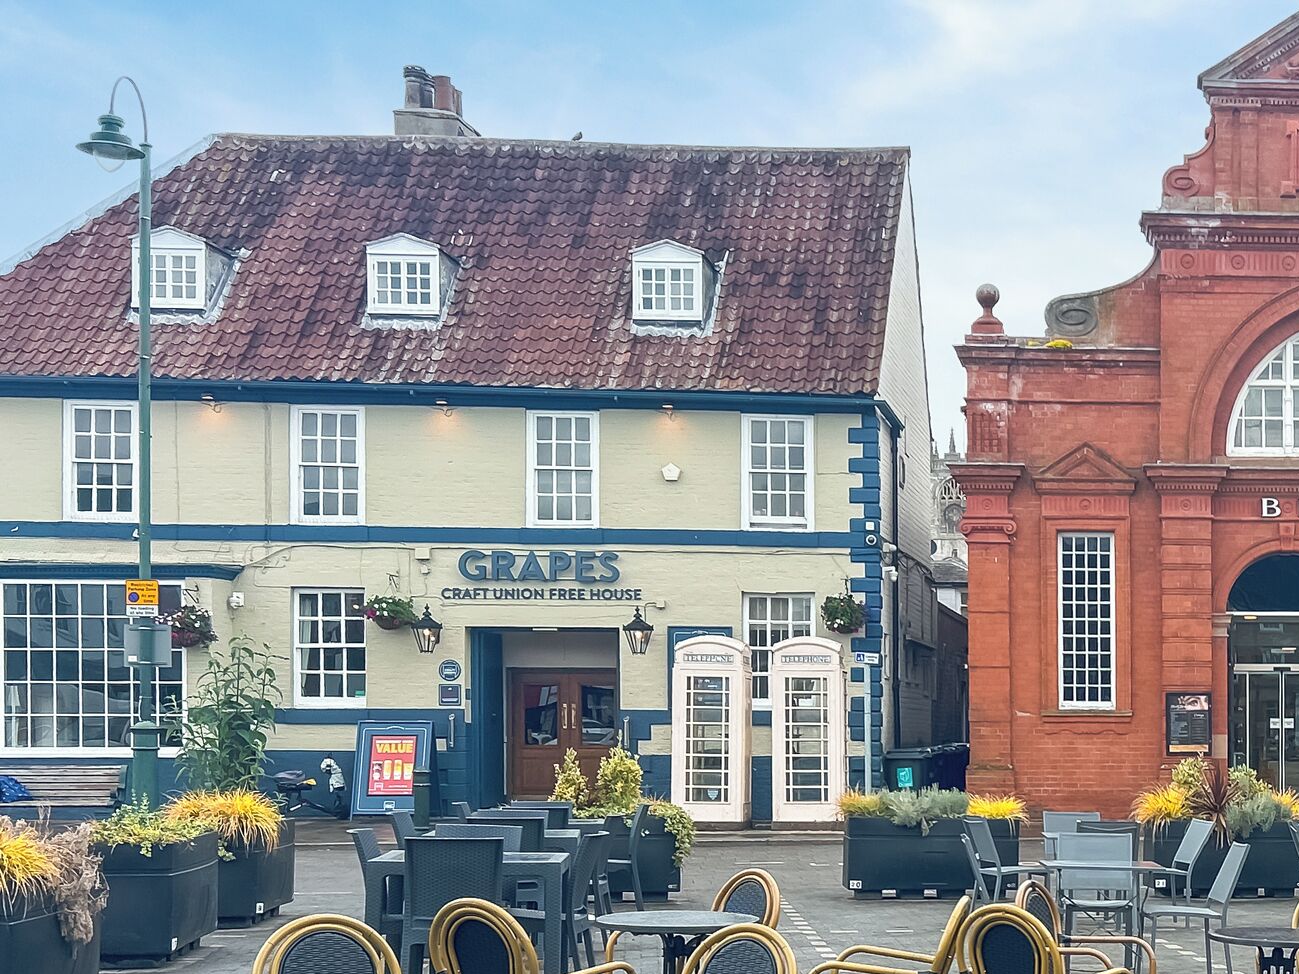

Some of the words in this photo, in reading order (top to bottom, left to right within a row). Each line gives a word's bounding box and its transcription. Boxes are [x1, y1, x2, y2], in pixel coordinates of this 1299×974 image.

[457, 549, 621, 584] GRAPES
[441, 587, 488, 600] CRAFT
[493, 588, 545, 600] UNION
[550, 588, 586, 600] FREE
[589, 588, 642, 601] HOUSE
[375, 743, 414, 754] VALUE
